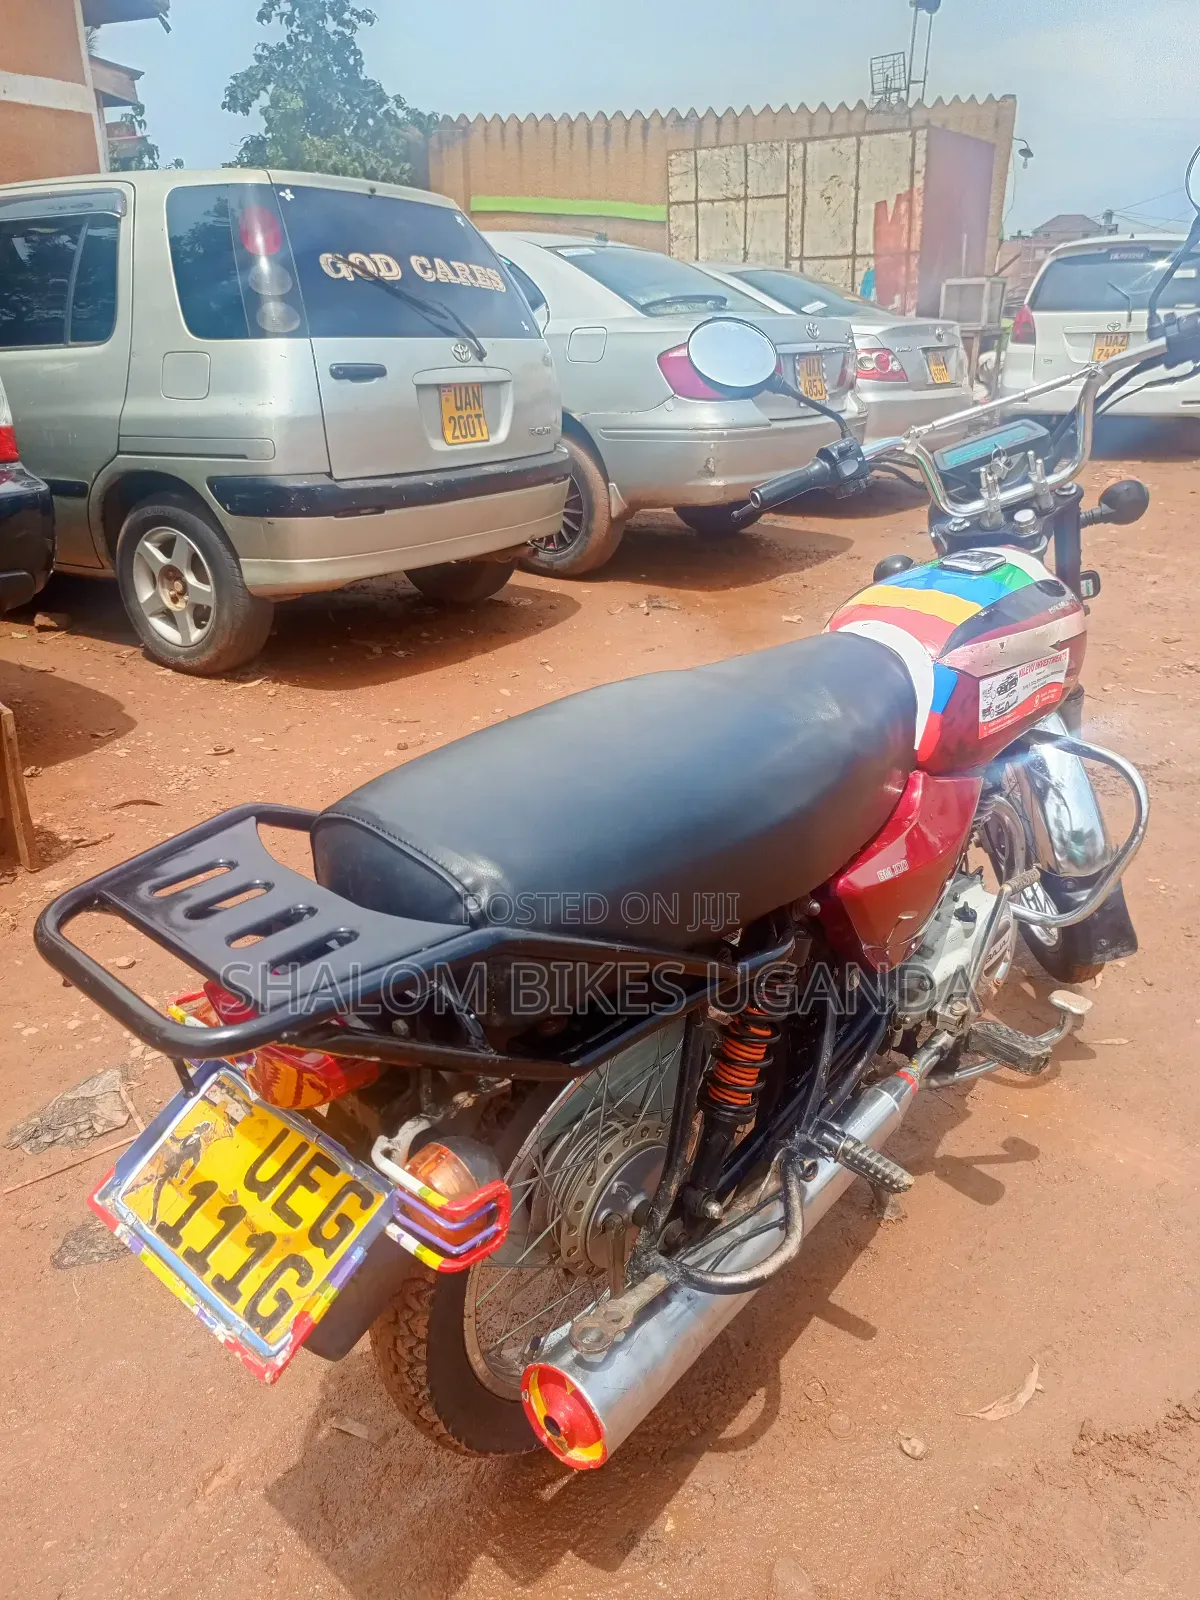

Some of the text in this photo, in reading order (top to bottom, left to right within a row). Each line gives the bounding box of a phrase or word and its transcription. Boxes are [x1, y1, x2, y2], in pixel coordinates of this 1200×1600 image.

[319, 253, 507, 292] GOD CARES
[1105, 335, 1127, 347] UAZ
[453, 386, 482, 411] UAN
[448, 413, 485, 440] 200T
[243, 1127, 375, 1260] UEG
[155, 1180, 314, 1335] 111G
